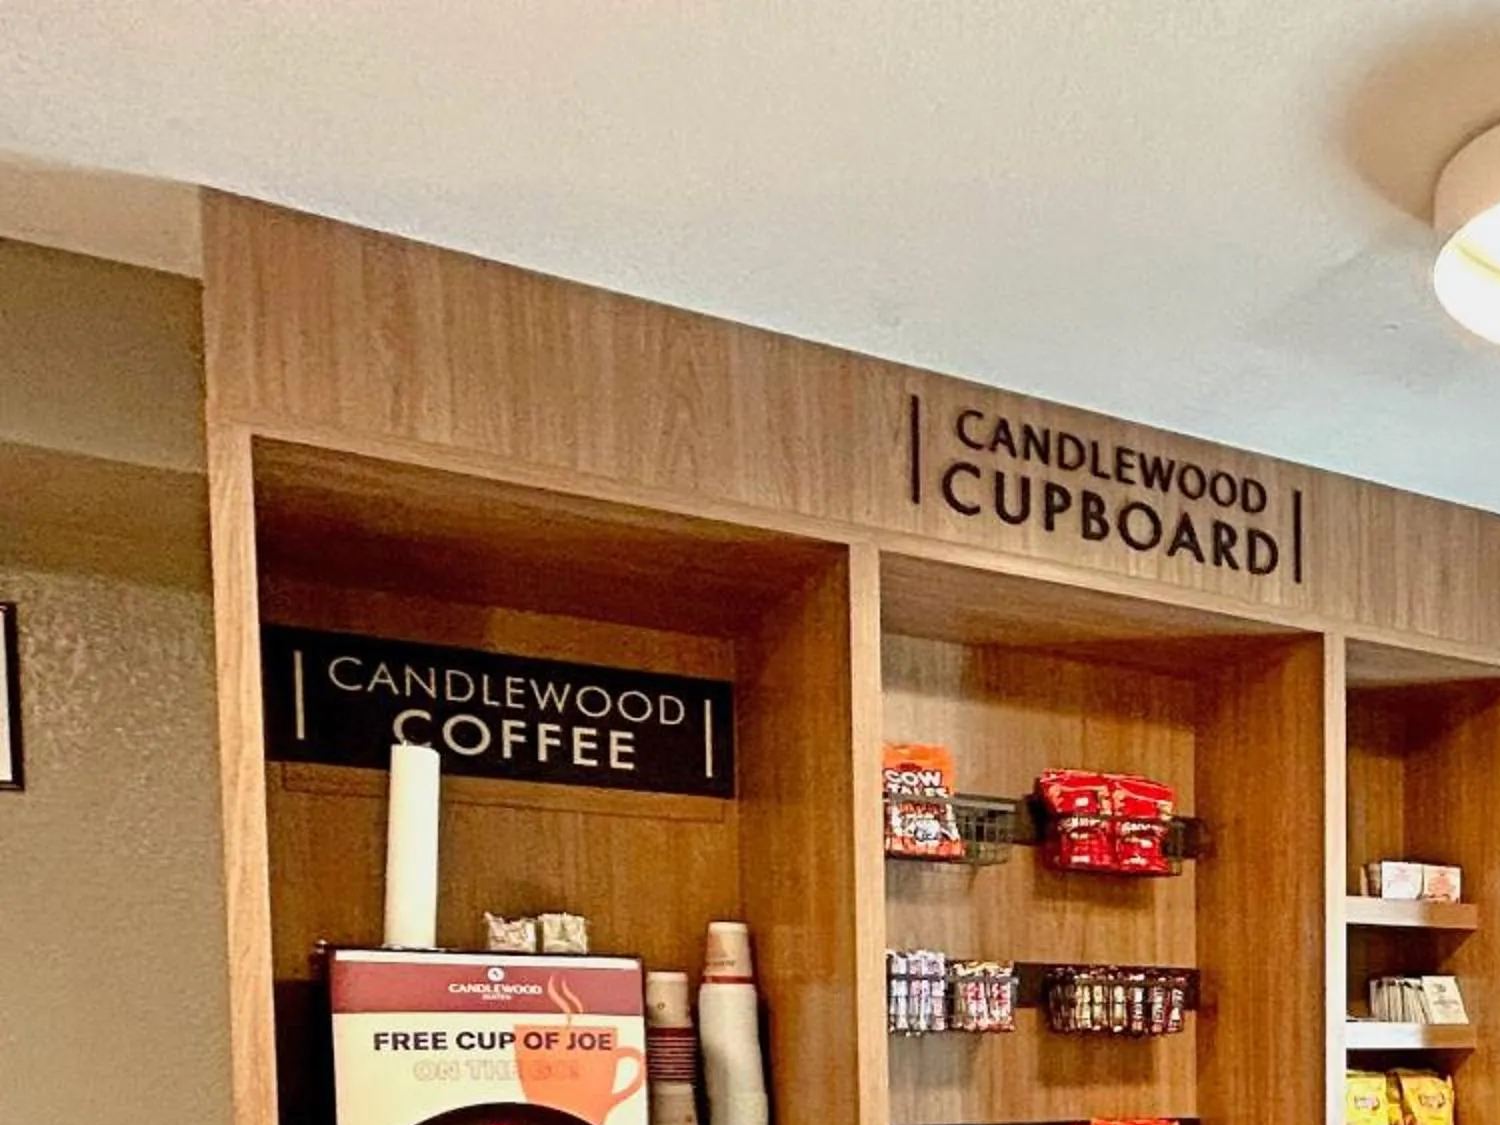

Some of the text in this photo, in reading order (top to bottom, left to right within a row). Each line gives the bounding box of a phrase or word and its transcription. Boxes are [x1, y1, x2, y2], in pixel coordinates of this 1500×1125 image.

[956, 410, 1267, 513] CANDLEWOOD
[942, 462, 1279, 575] CUPBOARD
[328, 656, 685, 725] CANDLEWOOD
[393, 708, 636, 770] COFFEE
[884, 770, 942, 788] COW
[448, 983, 543, 996] CANDLEWOOD
[373, 1031, 613, 1051] FREE CUP OF JOE
